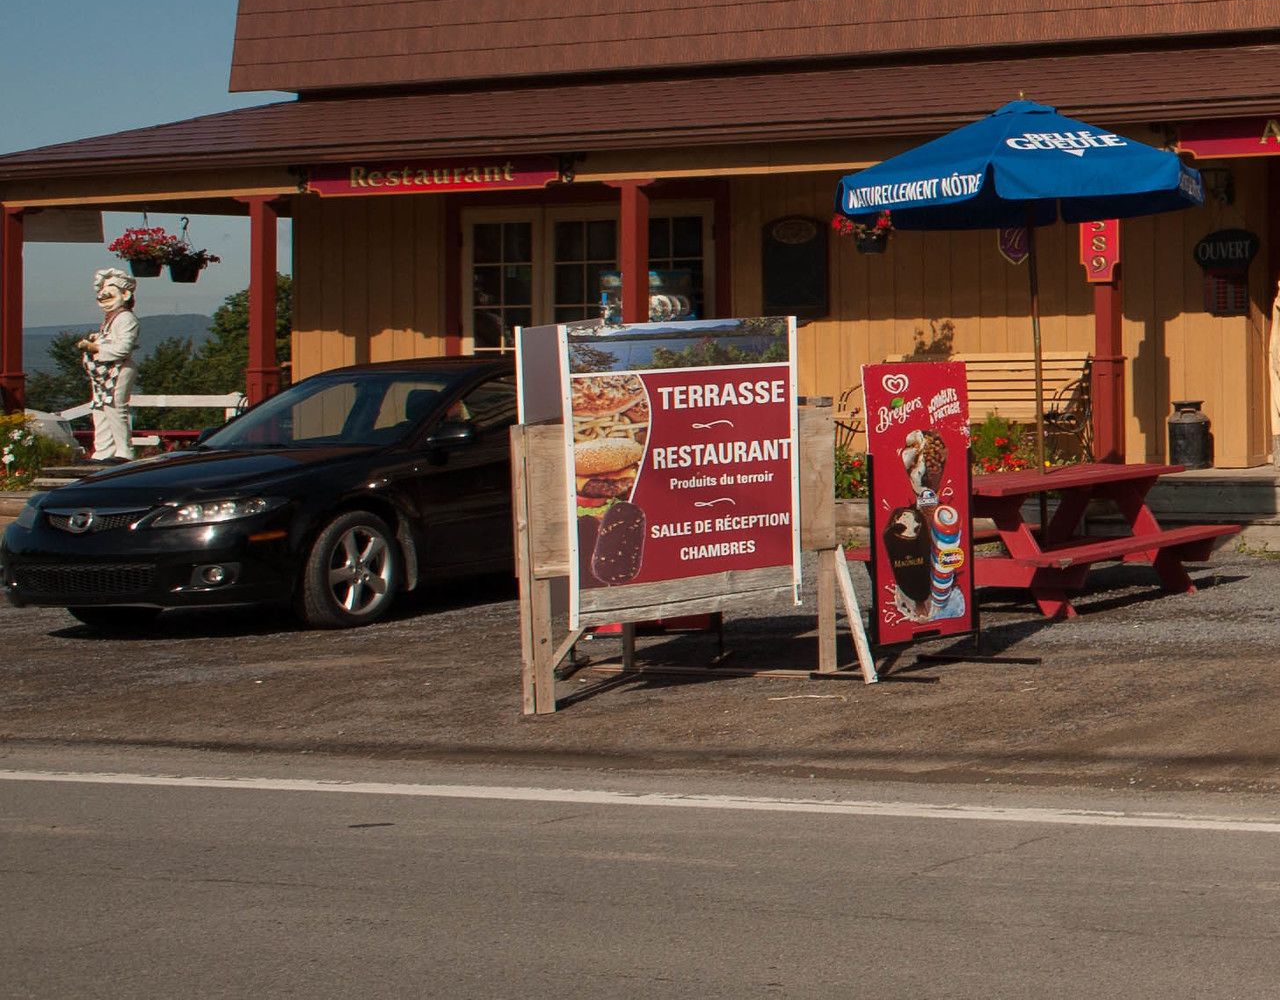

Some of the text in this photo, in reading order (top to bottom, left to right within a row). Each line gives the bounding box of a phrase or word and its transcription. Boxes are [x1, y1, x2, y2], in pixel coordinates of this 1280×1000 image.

[1006, 134, 1128, 150] GUEULE
[350, 161, 514, 188] Restaurant
[848, 177, 939, 209] NATURELLEMENT
[1199, 241, 1251, 260] OUVERT
[657, 380, 785, 410] TERRASSE
[875, 397, 922, 433] Breyers
[652, 438, 791, 470] RESTAURANT
[670, 471, 774, 490] Produits du terroir
[651, 513, 790, 538] SALLE DE RÉCEPTION
[680, 540, 756, 561] CHAMBRES
